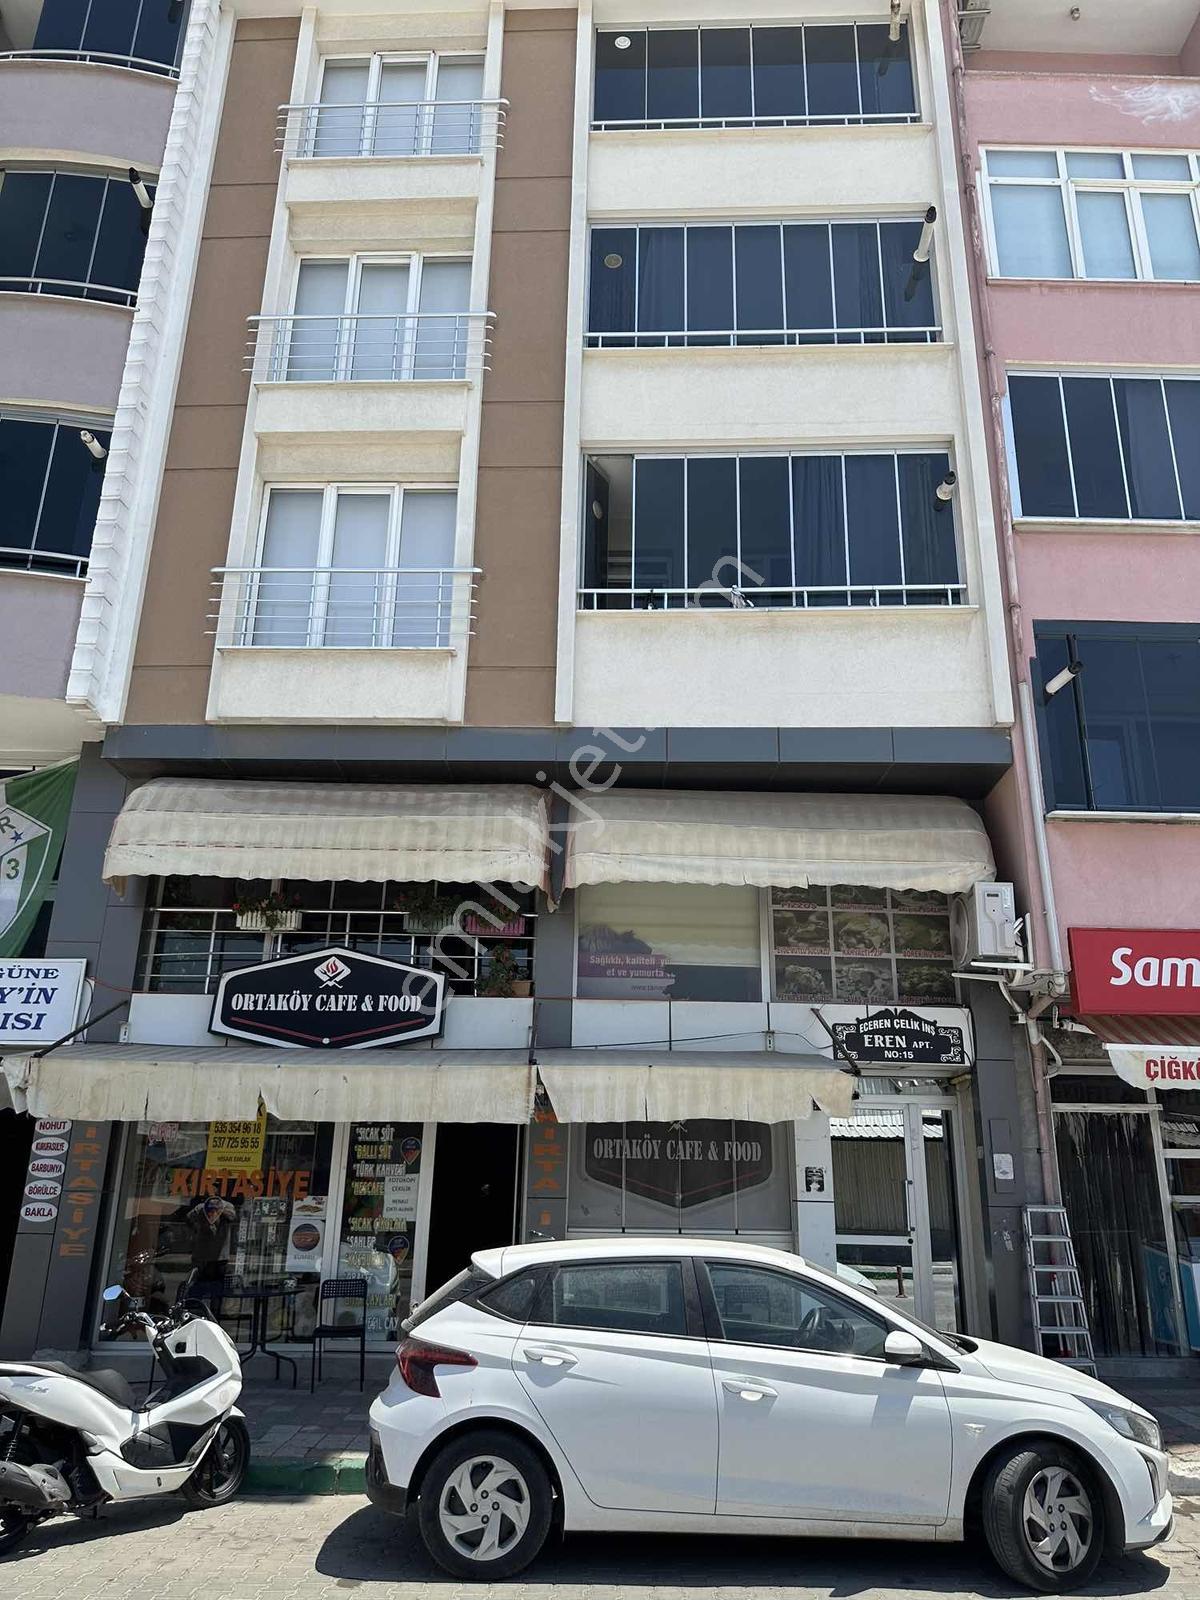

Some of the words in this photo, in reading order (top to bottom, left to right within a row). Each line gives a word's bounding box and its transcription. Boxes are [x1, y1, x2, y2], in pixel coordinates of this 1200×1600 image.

[6, 857, 20, 880] 3
[629, 968, 665, 979] yumurta
[230, 990, 313, 1012] ORTAKÖY
[315, 994, 359, 1012] CAFE
[361, 995, 374, 1012] &
[377, 995, 422, 1012] FOOD
[859, 1018, 891, 1034] ECEREN
[893, 1018, 920, 1031] ÇELİK
[863, 1034, 907, 1048] EREN
[912, 1041, 934, 1049] APT.
[884, 1050, 914, 1059] NO:15
[39, 1120, 68, 1131] NOHUT
[214, 1122, 228, 1134] 535
[593, 1133, 662, 1160] ORTAKÖY
[665, 1139, 704, 1161] CAFE
[707, 1140, 720, 1161] &
[723, 1140, 762, 1162] FOOD
[31, 1163, 63, 1174] BARBUNYA
[28, 1184, 58, 1196] BÖRÜLCE
[170, 1167, 312, 1201] KIRTASİYE
[24, 1207, 54, 1218] BAKLA
